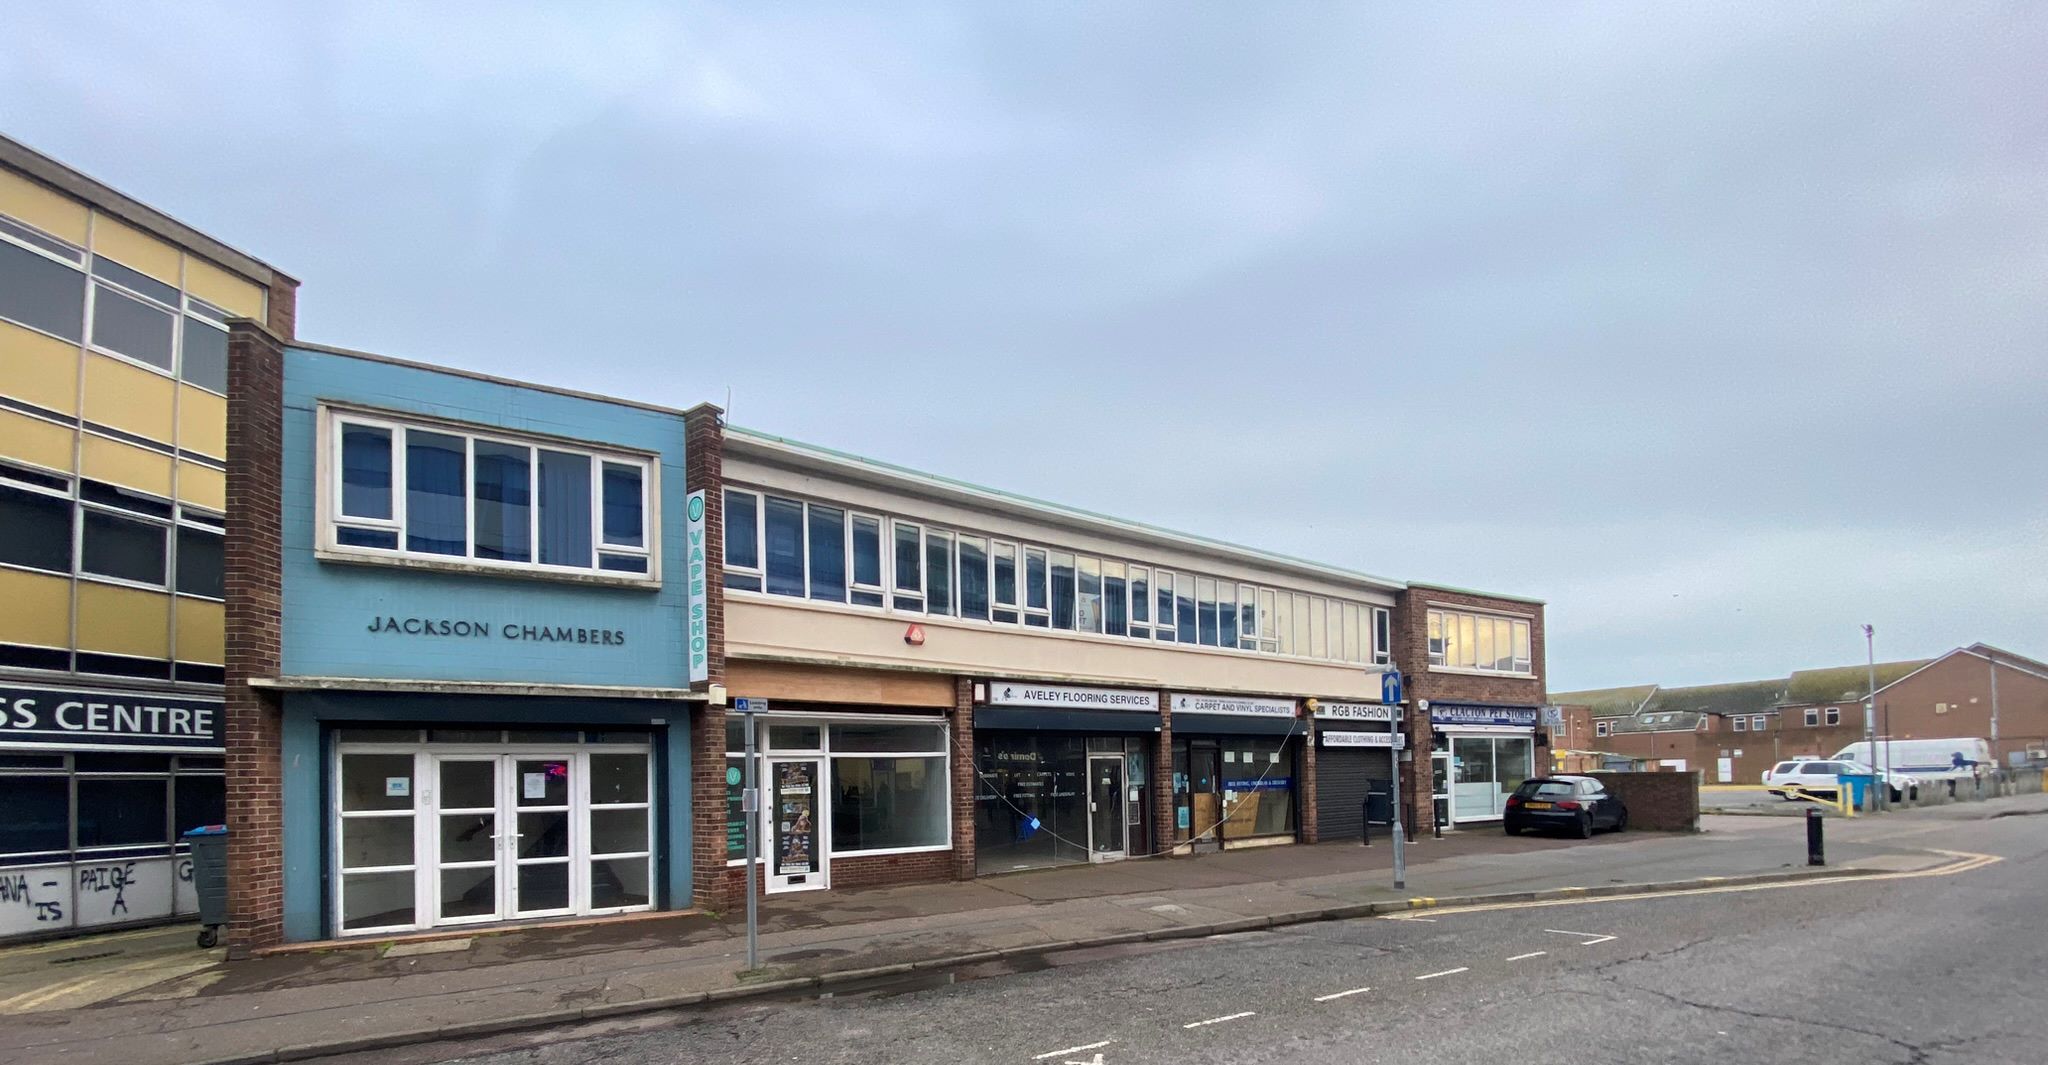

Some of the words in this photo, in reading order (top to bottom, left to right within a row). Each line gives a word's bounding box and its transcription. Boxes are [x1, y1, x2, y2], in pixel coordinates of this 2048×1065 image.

[689, 530, 704, 596] VAPE
[368, 616, 489, 637] JACKSON
[503, 624, 625, 646] CHAMBERS
[691, 604, 705, 669] SHOP
[1024, 690, 1061, 701] AVELEY
[1063, 692, 1108, 704] FLOORING
[1110, 694, 1150, 705] SERVICES
[1195, 702, 1221, 711] CARPET
[1222, 703, 1235, 712] AND
[1236, 704, 1253, 713] VINYL
[1254, 705, 1290, 714] SPECIALISTS
[1332, 705, 1350, 717] RGB
[1352, 706, 1389, 718] FASHION
[1450, 706, 1486, 717] CLACTON
[1489, 708, 1502, 717] PET
[1507, 708, 1534, 719] STORES
[55, 701, 214, 735] CENTRE
[80, 862, 136, 892] PAIGE
[35, 901, 62, 921] IS
[112, 886, 128, 915] A
